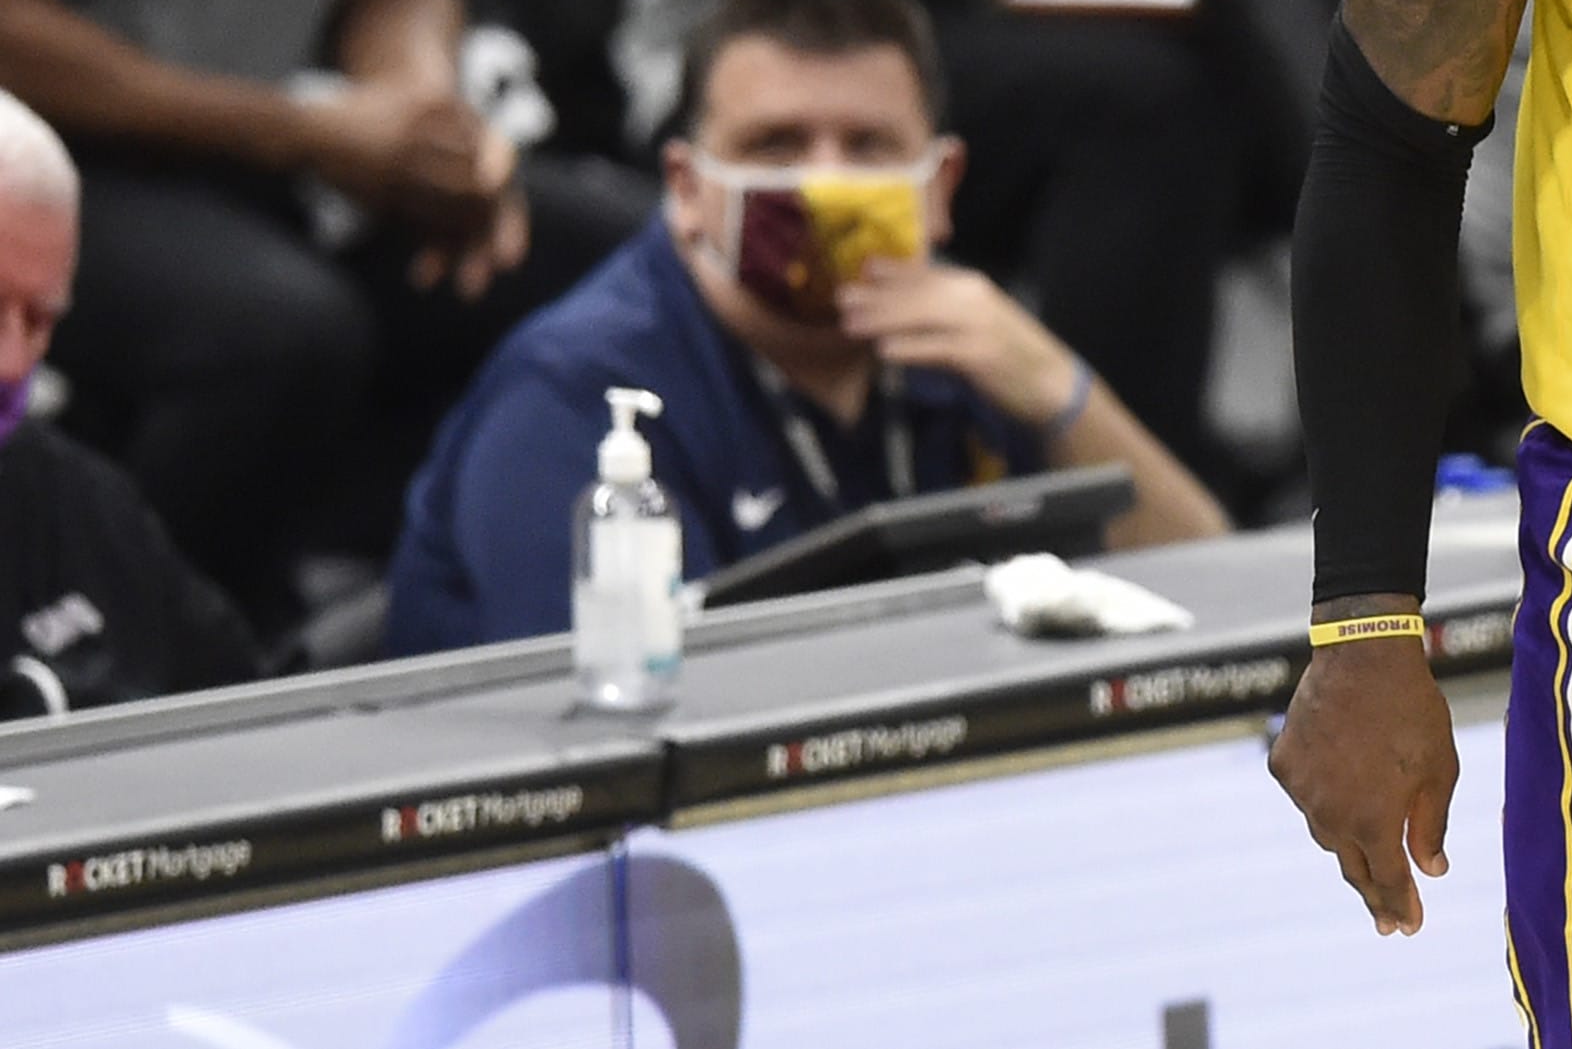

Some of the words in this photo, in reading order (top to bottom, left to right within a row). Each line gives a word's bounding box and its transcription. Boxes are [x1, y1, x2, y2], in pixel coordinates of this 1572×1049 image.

[1338, 619, 1411, 636] PROMISE
[381, 794, 477, 842] ROCKET
[47, 849, 144, 898] ROCKET
